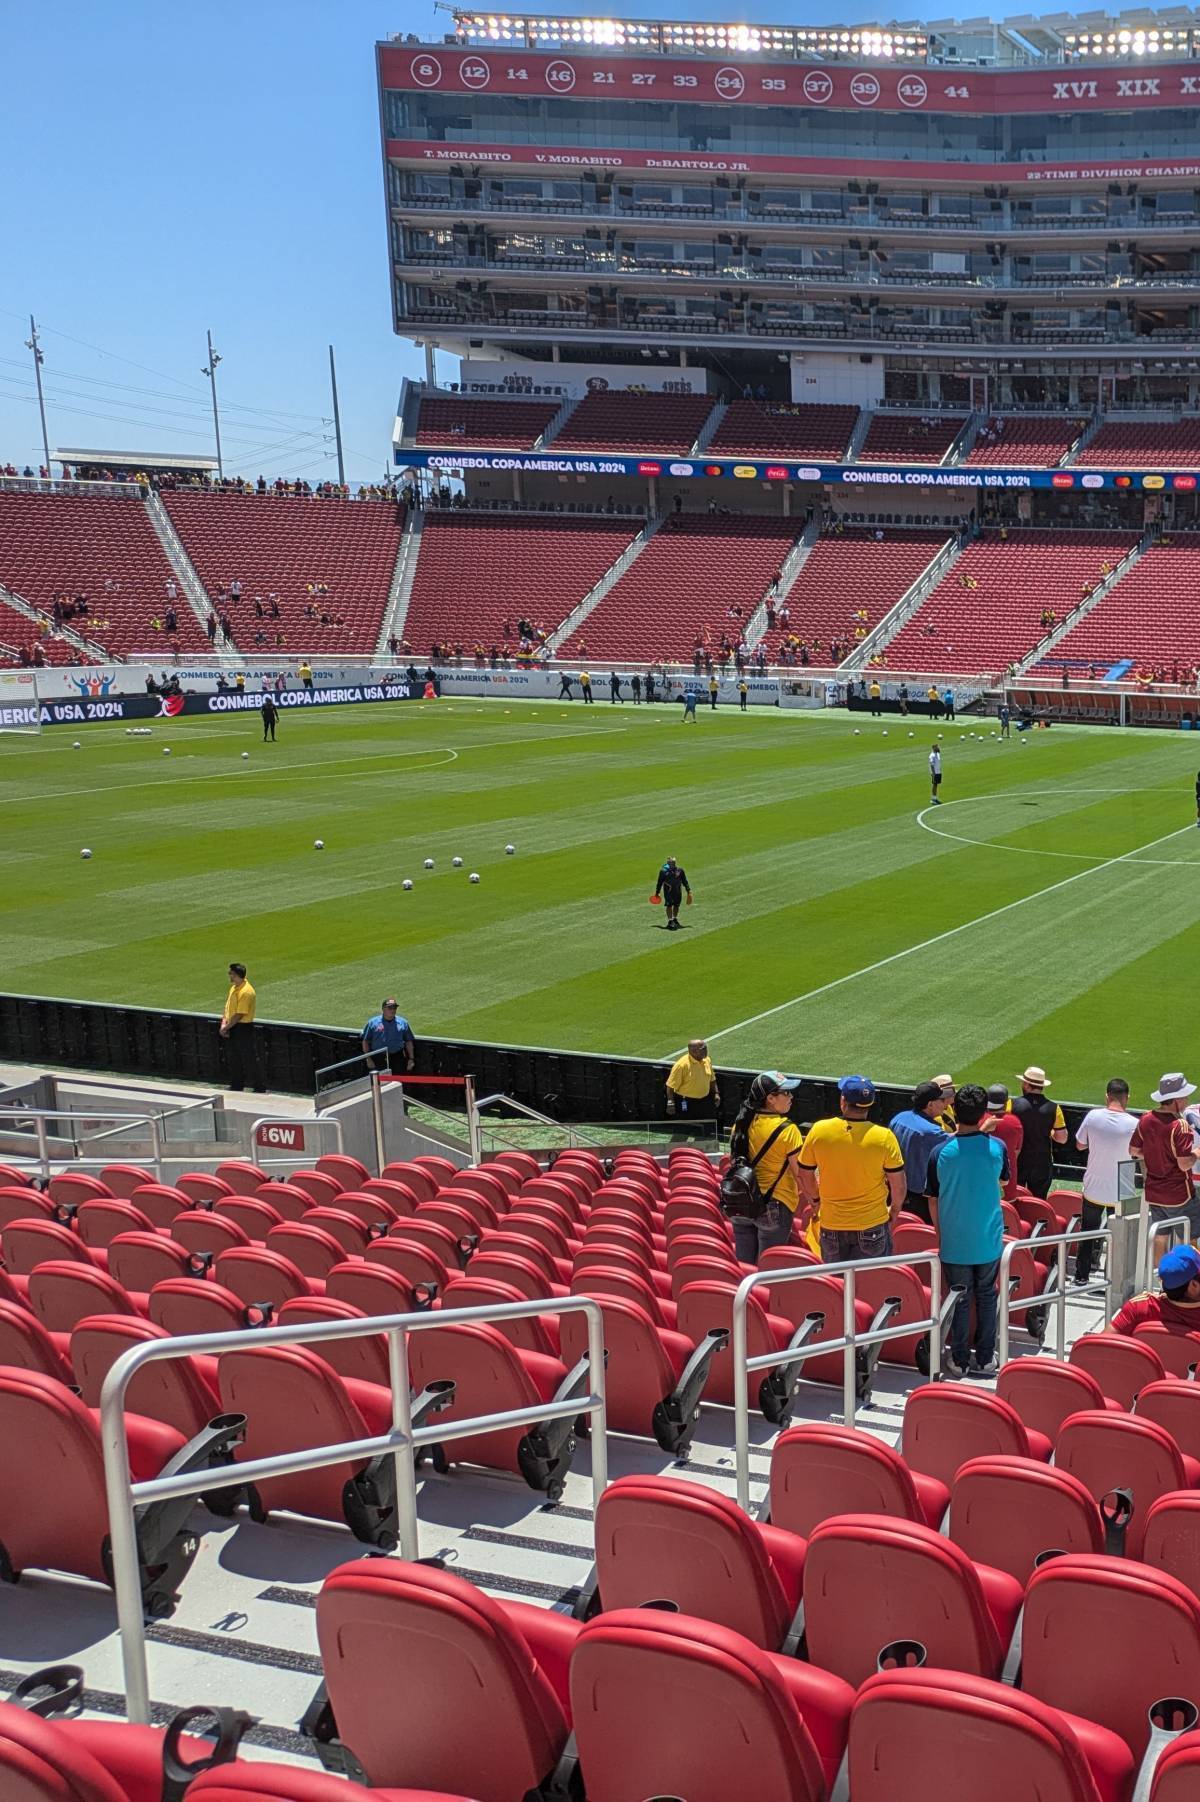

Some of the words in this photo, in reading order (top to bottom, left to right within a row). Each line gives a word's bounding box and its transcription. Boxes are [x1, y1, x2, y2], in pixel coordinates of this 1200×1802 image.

[419, 64, 433, 76] 8
[464, 66, 486, 78] 12
[507, 68, 528, 80] 14
[550, 70, 571, 82] 16
[592, 72, 615, 84] 21
[632, 74, 656, 85] 27
[673, 75, 698, 87] 33
[718, 77, 742, 89] 34
[762, 78, 786, 90] 35
[806, 81, 830, 92] 37
[852, 83, 877, 94] 39
[900, 84, 925, 96] 42
[944, 86, 970, 98] 44
[1053, 81, 1097, 99] XVI
[1116, 78, 1160, 96] XIX
[424, 150, 435, 158] T.
[438, 150, 512, 161] MORABITO
[536, 154, 546, 162] V.
[549, 155, 622, 166] MORABITO
[730, 162, 750, 171] JR.
[1081, 168, 1142, 178] DIVISION
[428, 456, 492, 468] CONMEBOL
[492, 458, 523, 470] COPA
[524, 460, 573, 472] AMERICA
[576, 462, 597, 472] USA
[599, 462, 626, 474] 2024
[842, 471, 904, 484] CONMEBOL
[906, 473, 935, 484] COPA
[936, 474, 982, 486] AMERICA
[984, 476, 1004, 486] USA
[1006, 476, 1030, 486] 2024
[455, 674, 492, 682] AMERICA
[510, 676, 529, 684] 2024
[280, 692, 311, 706] COPA
[311, 689, 362, 704] AMERICA
[364, 688, 384, 700] USA
[386, 686, 410, 698] 2024
[54, 704, 84, 720] USA
[87, 702, 122, 718] 2024
[268, 1127, 295, 1144] 6W
[182, 1538, 197, 1556] 14
